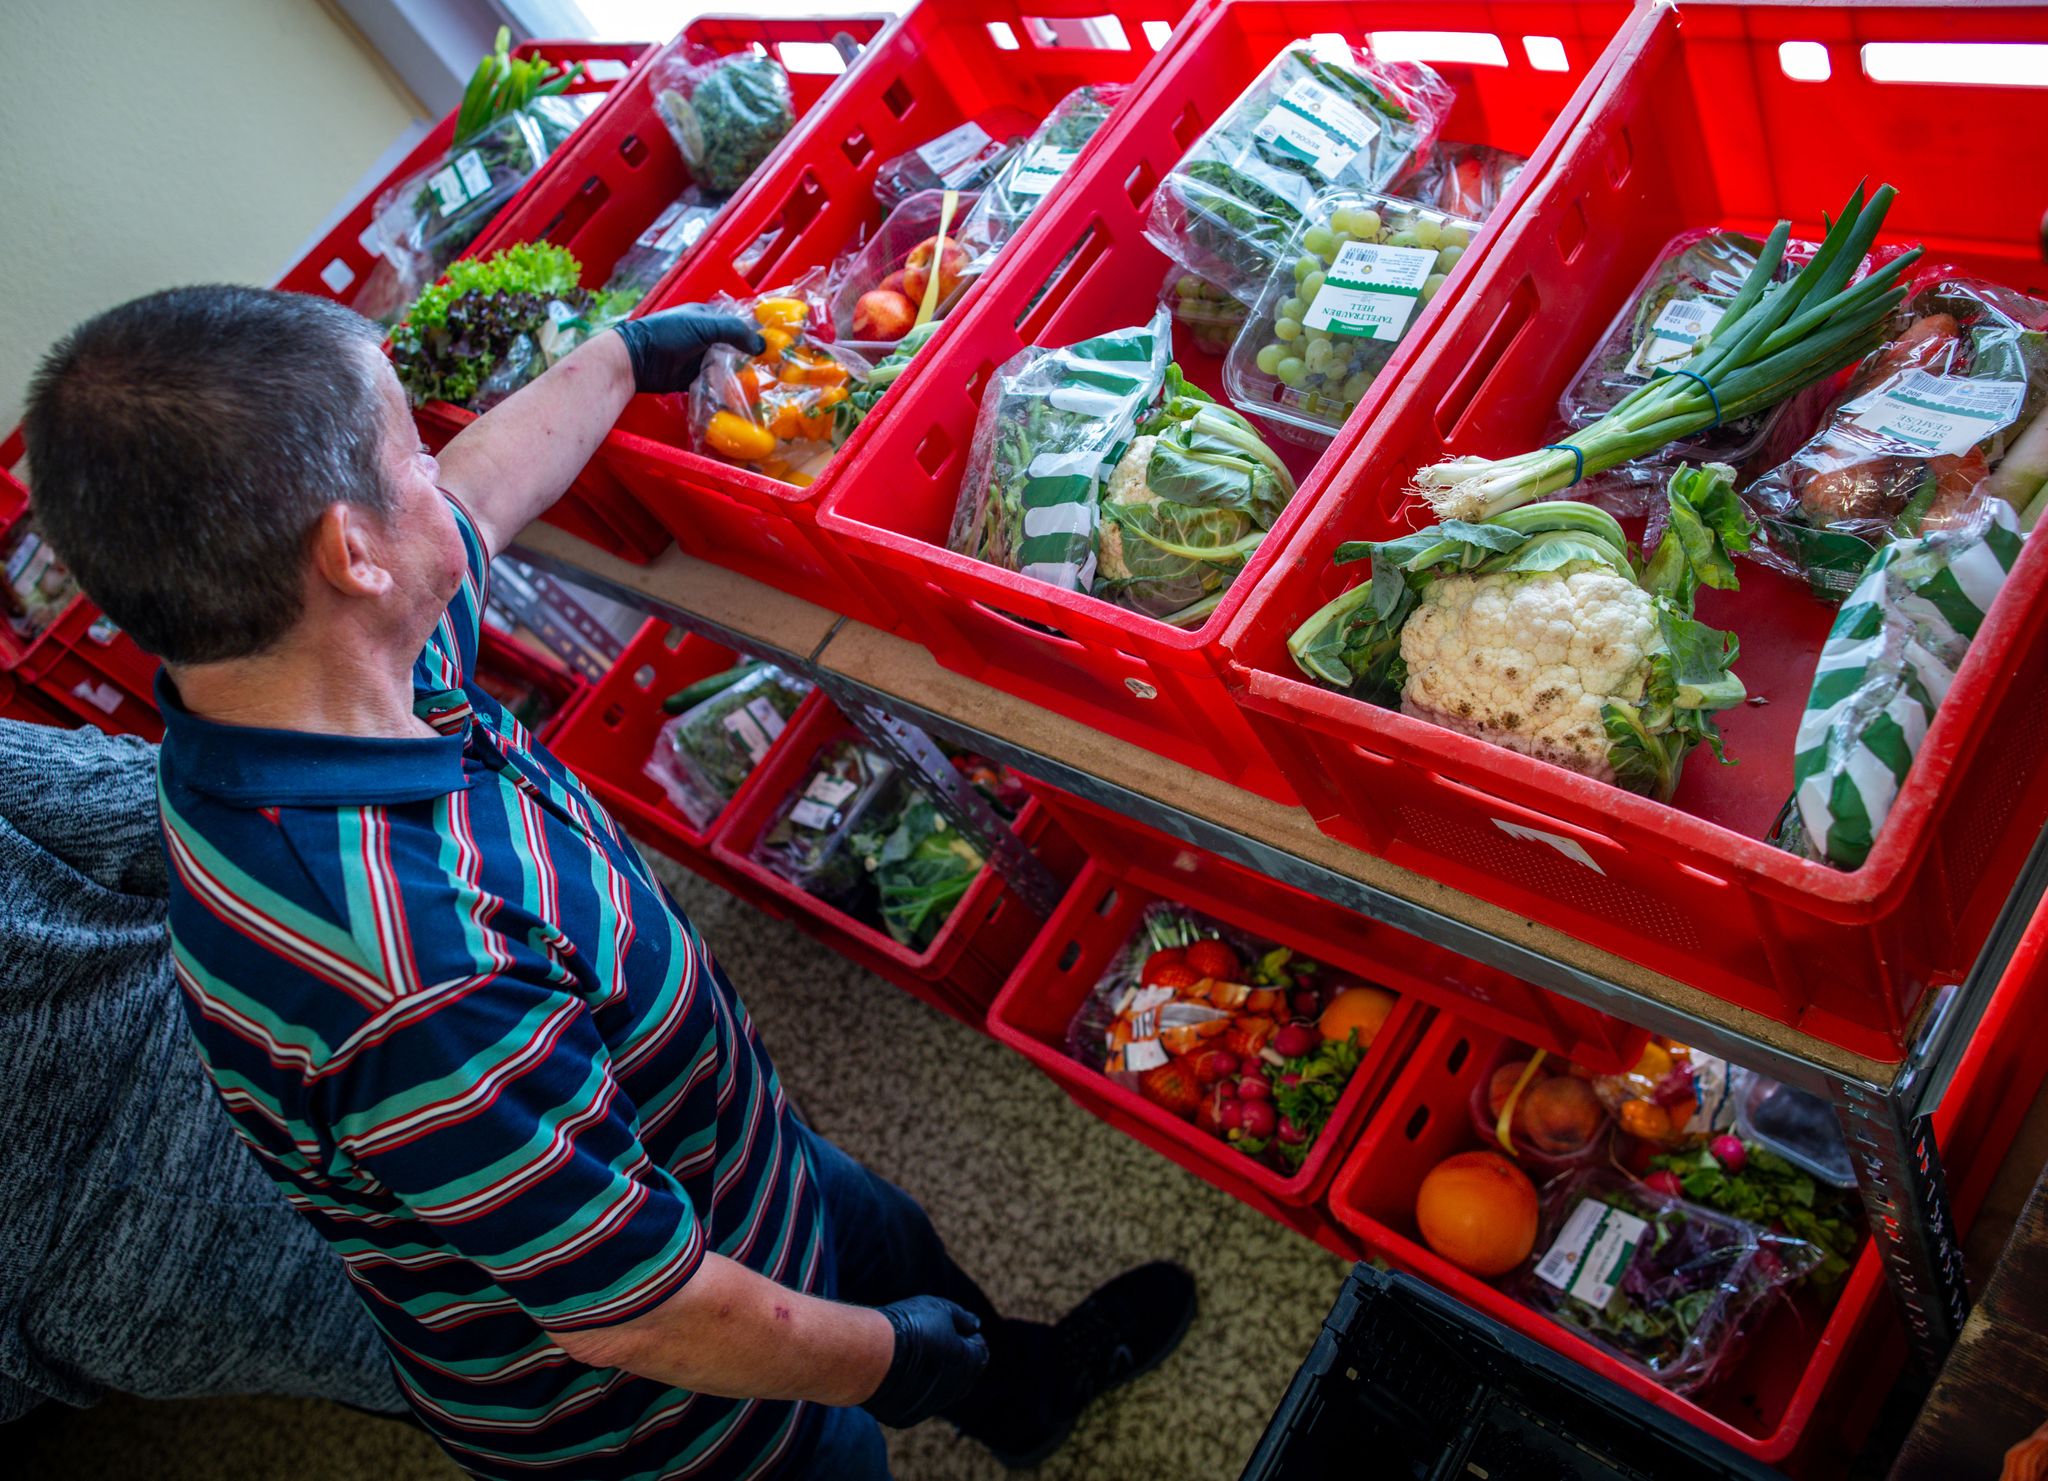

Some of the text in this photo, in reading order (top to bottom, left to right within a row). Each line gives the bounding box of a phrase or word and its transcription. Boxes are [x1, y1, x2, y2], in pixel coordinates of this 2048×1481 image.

[1291, 130, 1320, 150] RUCOLA
[1322, 307, 1393, 324] TAFELTRAUBEN
[1350, 303, 1376, 313] HELL
